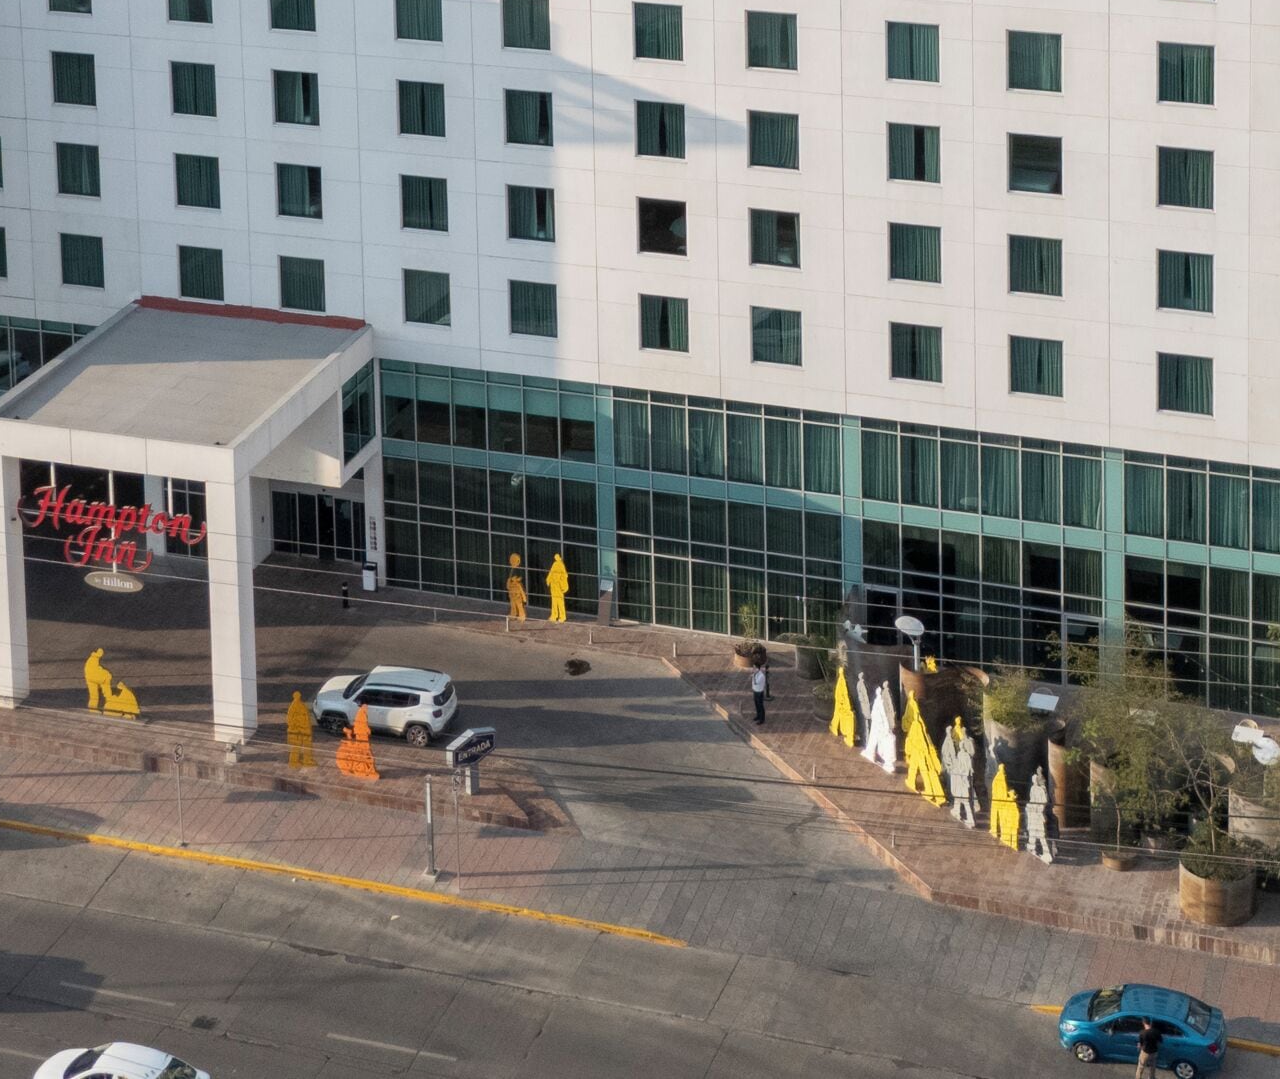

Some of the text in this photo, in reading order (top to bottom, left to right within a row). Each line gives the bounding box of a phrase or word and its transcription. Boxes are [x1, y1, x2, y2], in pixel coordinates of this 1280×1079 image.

[17, 484, 207, 546] Hampton
[64, 524, 153, 573] Inn
[102, 576, 134, 589] Hilton
